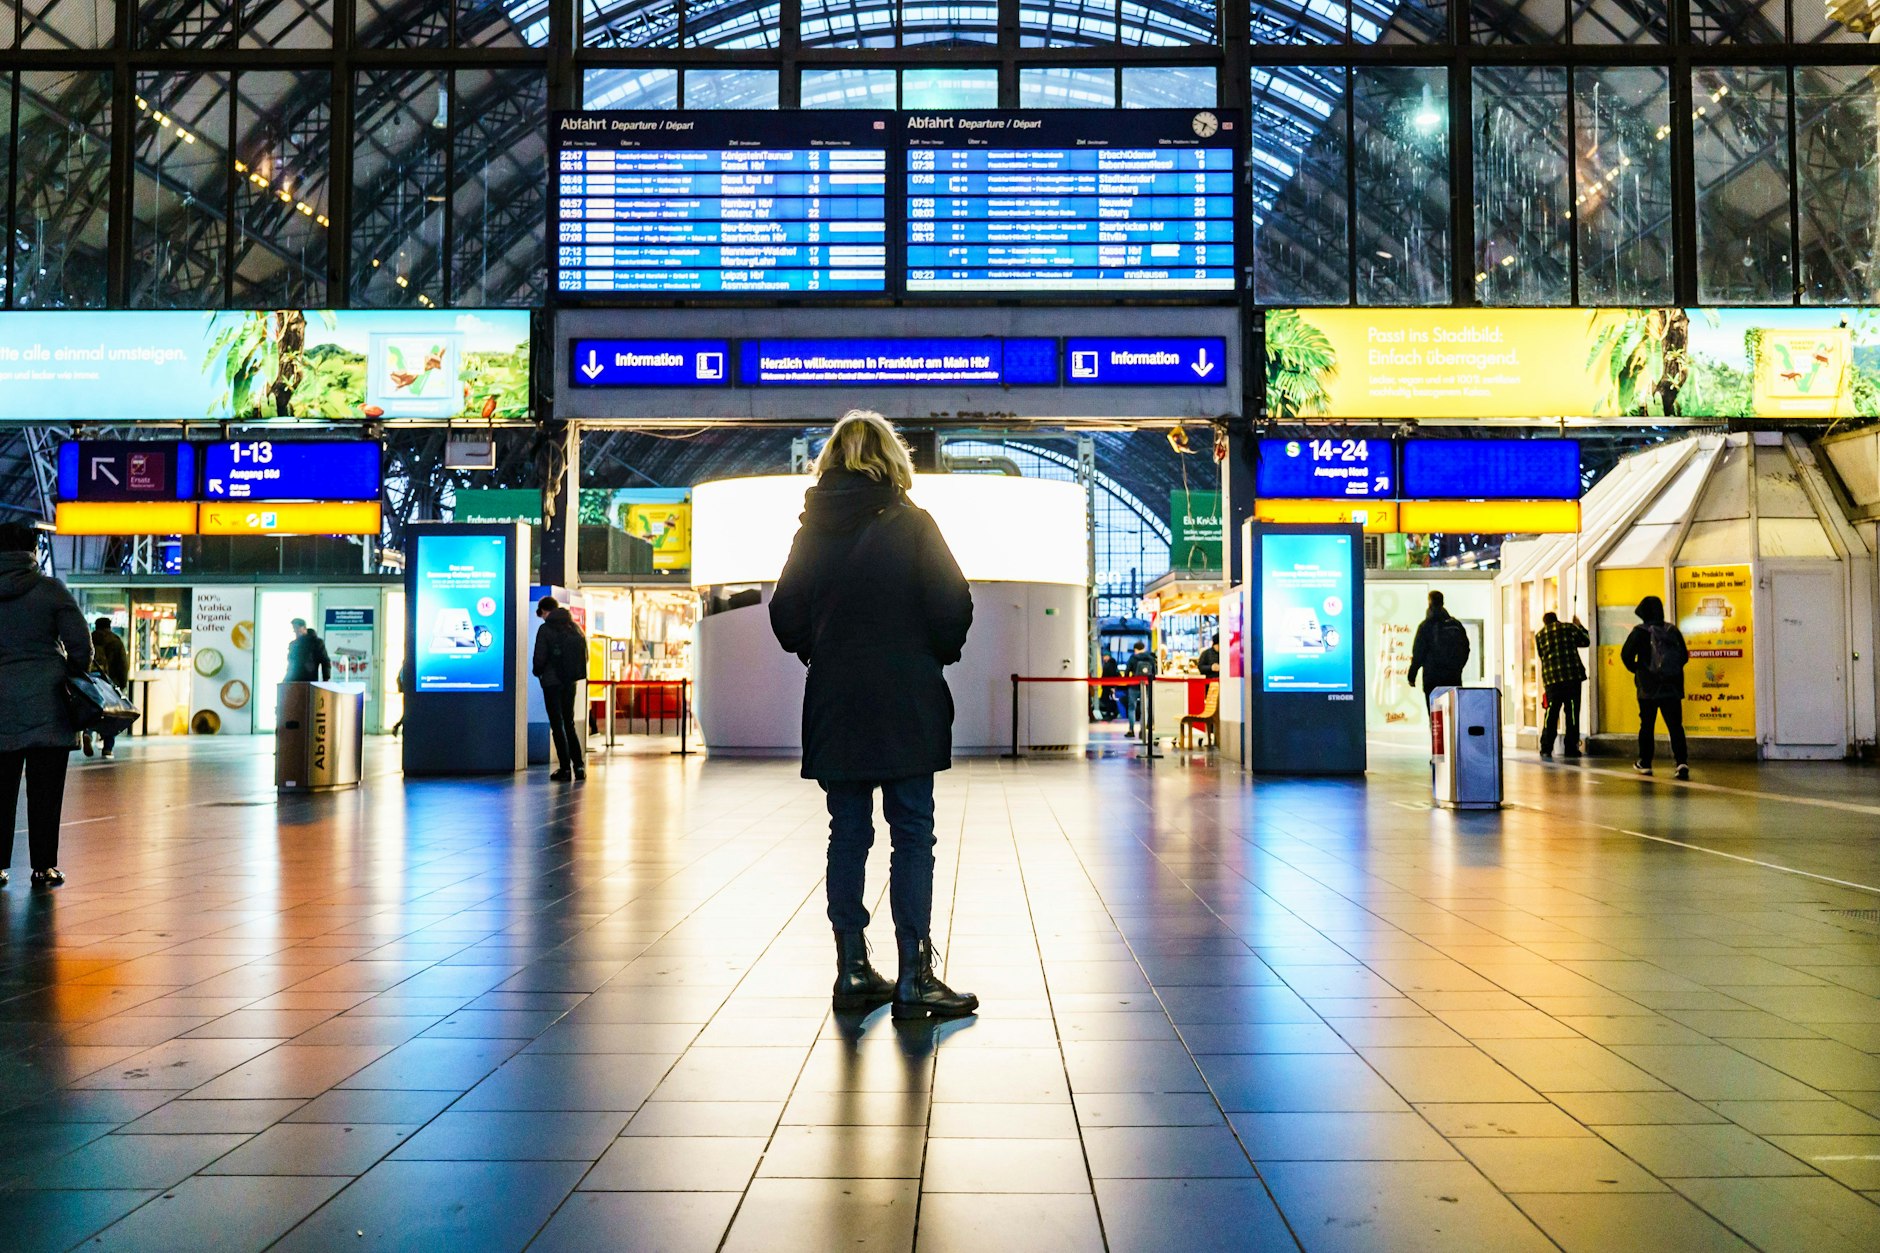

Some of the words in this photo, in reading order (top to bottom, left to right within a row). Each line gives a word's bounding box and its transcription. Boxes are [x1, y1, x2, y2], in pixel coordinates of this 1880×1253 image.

[560, 117, 607, 130] Abfahrt
[610, 120, 658, 132] Departure
[659, 120, 665, 130] /
[666, 120, 694, 132] Départ
[907, 116, 954, 129] Abfahrt
[958, 118, 1005, 130] Departure
[1006, 118, 1012, 129] /
[1012, 119, 1042, 130] Départ
[560, 151, 582, 160] 23:47
[808, 151, 819, 160] 22
[1195, 150, 1204, 161] 12
[751, 161, 765, 170] Hbf
[809, 161, 819, 170] 15
[1099, 174, 1155, 186] Stadtallendorf
[809, 185, 819, 194] 24
[1099, 185, 1138, 195] Dillenburg
[721, 199, 758, 210] Hamburg
[758, 199, 772, 210] Hbf
[912, 199, 934, 207] 07:53
[1194, 198, 1205, 209] 23
[755, 209, 769, 218] Hbf
[808, 209, 819, 218] 22
[1195, 208, 1205, 217] 20
[1099, 222, 1148, 233] Saarbrücken
[1150, 222, 1164, 231] Hbf
[721, 233, 770, 242] Saarbrücken
[773, 233, 786, 242] Hbf
[808, 233, 819, 242] 20
[1195, 232, 1205, 240] 24
[559, 247, 581, 256] 07:12
[809, 246, 819, 257] 17
[1128, 246, 1142, 257] Hbf
[559, 257, 582, 266] 07:17
[809, 257, 819, 265] 15
[1127, 256, 1141, 265] Hbf
[721, 271, 747, 281] Leipzig
[750, 271, 764, 279] Hbf
[913, 271, 934, 280] 08:23
[1192, 270, 1209, 280] 23
[559, 281, 581, 290] 07:23
[721, 280, 789, 289] Assmannshausen
[808, 280, 819, 289] 23
[1368, 326, 1404, 343] Passt
[1409, 327, 1428, 342] ins
[1433, 325, 1504, 343] Stadtbild:
[23, 344, 50, 360] alle
[54, 344, 104, 360] einmal
[108, 345, 187, 365] umsteigen.
[1110, 351, 1180, 366] Information
[1368, 348, 1422, 366] Einfach
[1426, 348, 1520, 370] überragend.
[615, 352, 684, 367] Information
[760, 357, 802, 370] Herzlich
[803, 357, 866, 370] willkommen
[866, 357, 877, 370] in
[878, 356, 924, 368] Frankfurt
[925, 358, 942, 368] am
[943, 356, 970, 368] Main
[970, 356, 990, 368] Hbf
[230, 441, 272, 464] 1-13
[1286, 441, 1300, 457] S
[1309, 439, 1368, 461] 14-24
[230, 469, 263, 480] Ausgang
[1314, 466, 1348, 478] Ausgang
[1348, 466, 1368, 477] Nord
[198, 594, 221, 602] 100%
[197, 603, 232, 612] Arabica
[196, 613, 232, 622] Organic
[196, 624, 225, 632] Coffee
[1688, 694, 1713, 702] KENO
[315, 712, 326, 770] Abfall
